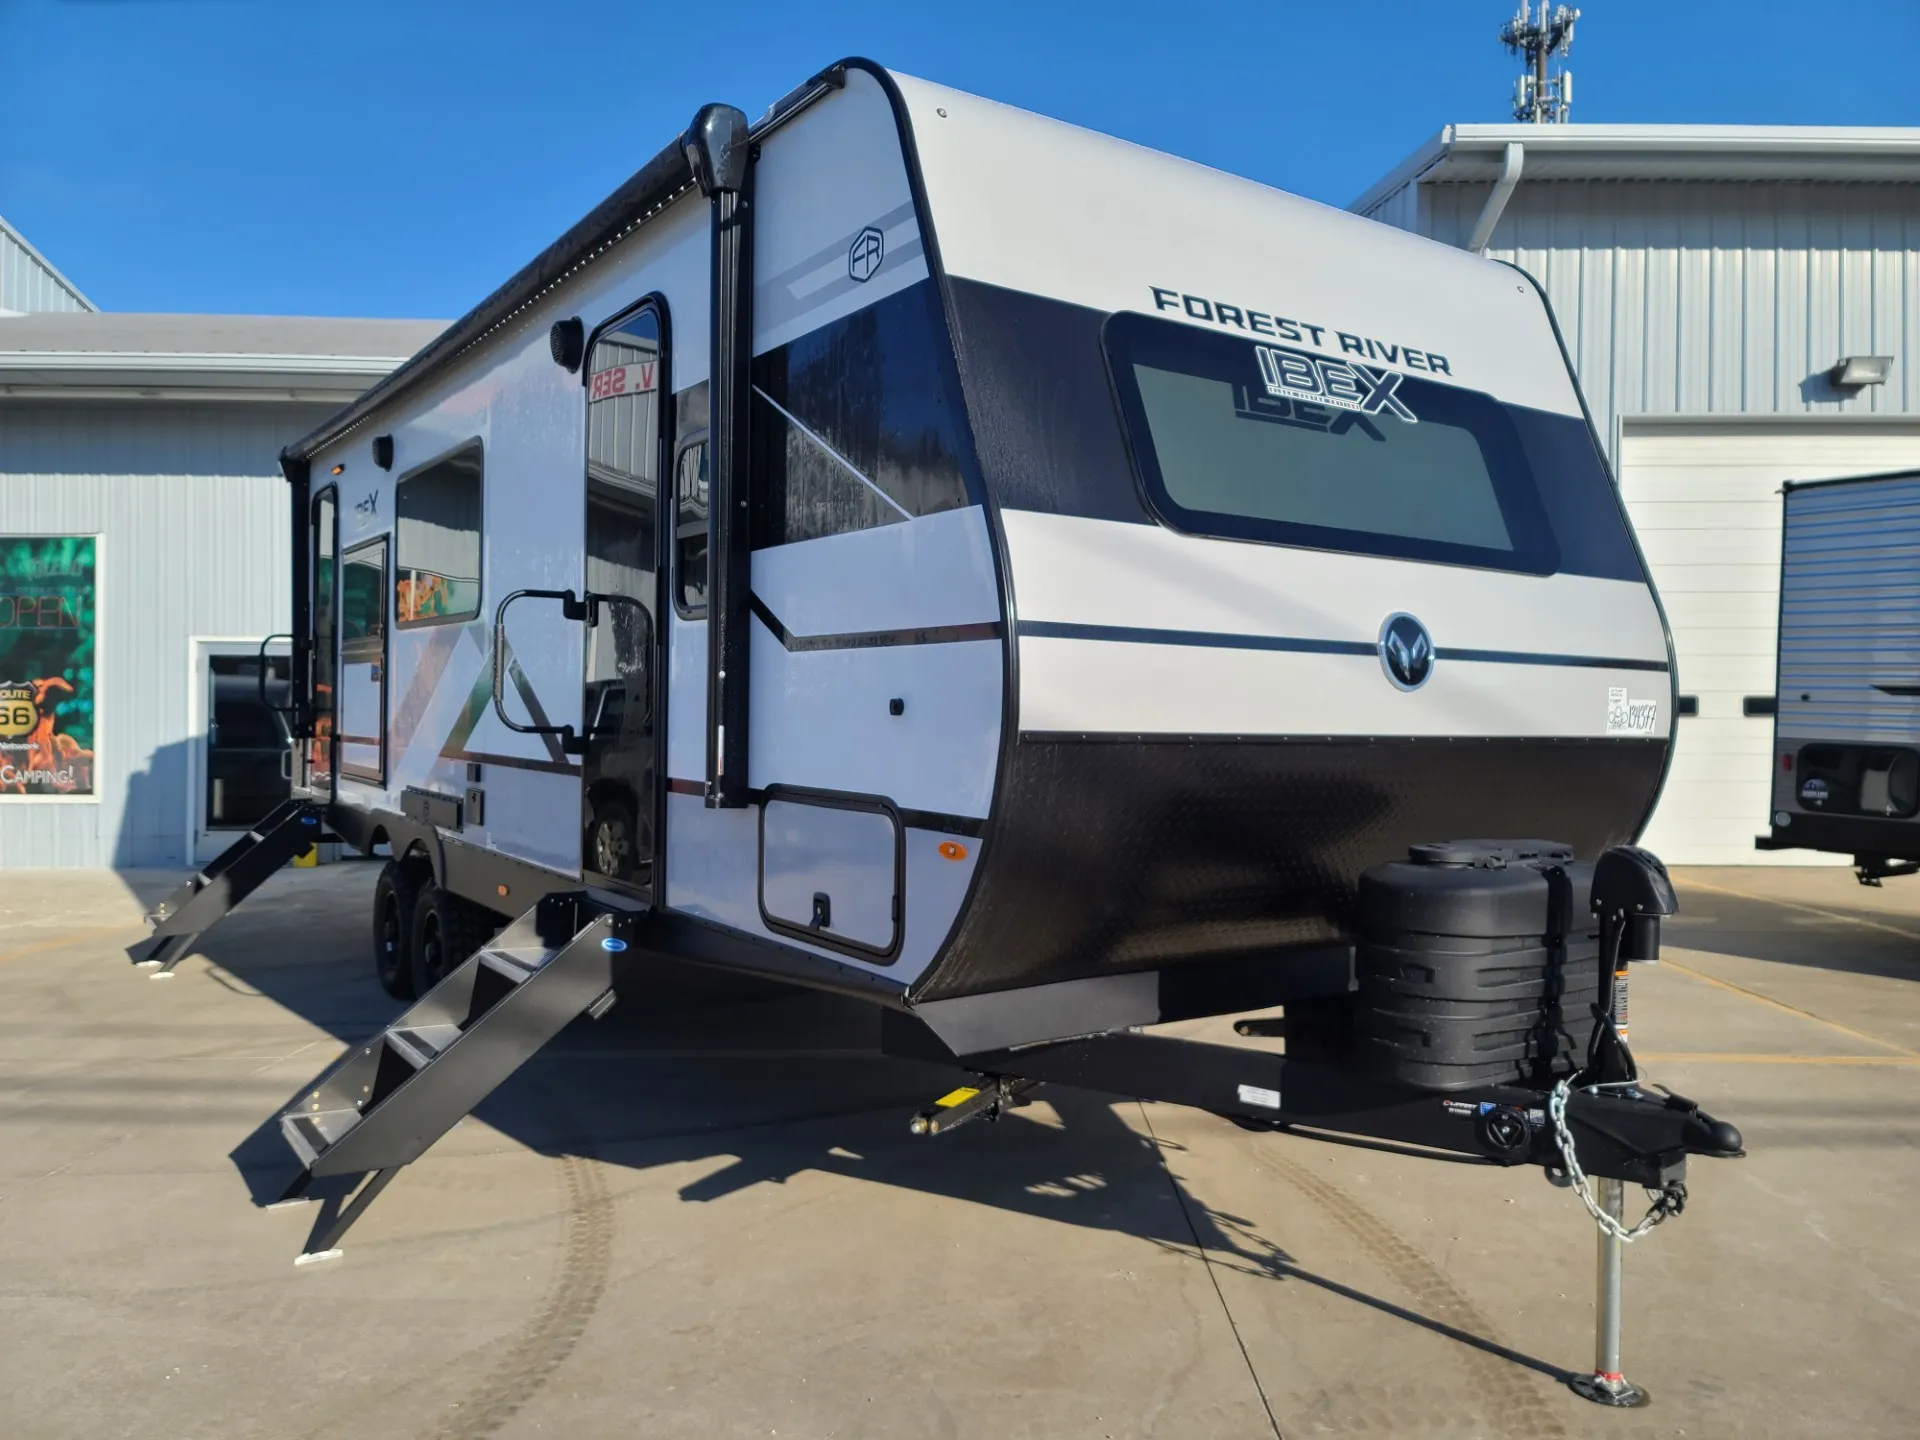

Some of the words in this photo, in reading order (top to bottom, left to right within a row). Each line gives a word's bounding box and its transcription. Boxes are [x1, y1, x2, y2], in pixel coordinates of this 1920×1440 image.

[1147, 285, 1326, 347] FOREST
[1334, 330, 1453, 376] RIVER
[1255, 346, 1418, 423] IBEX
[0, 596, 82, 627] OPEN
[0, 689, 31, 699] OUTE
